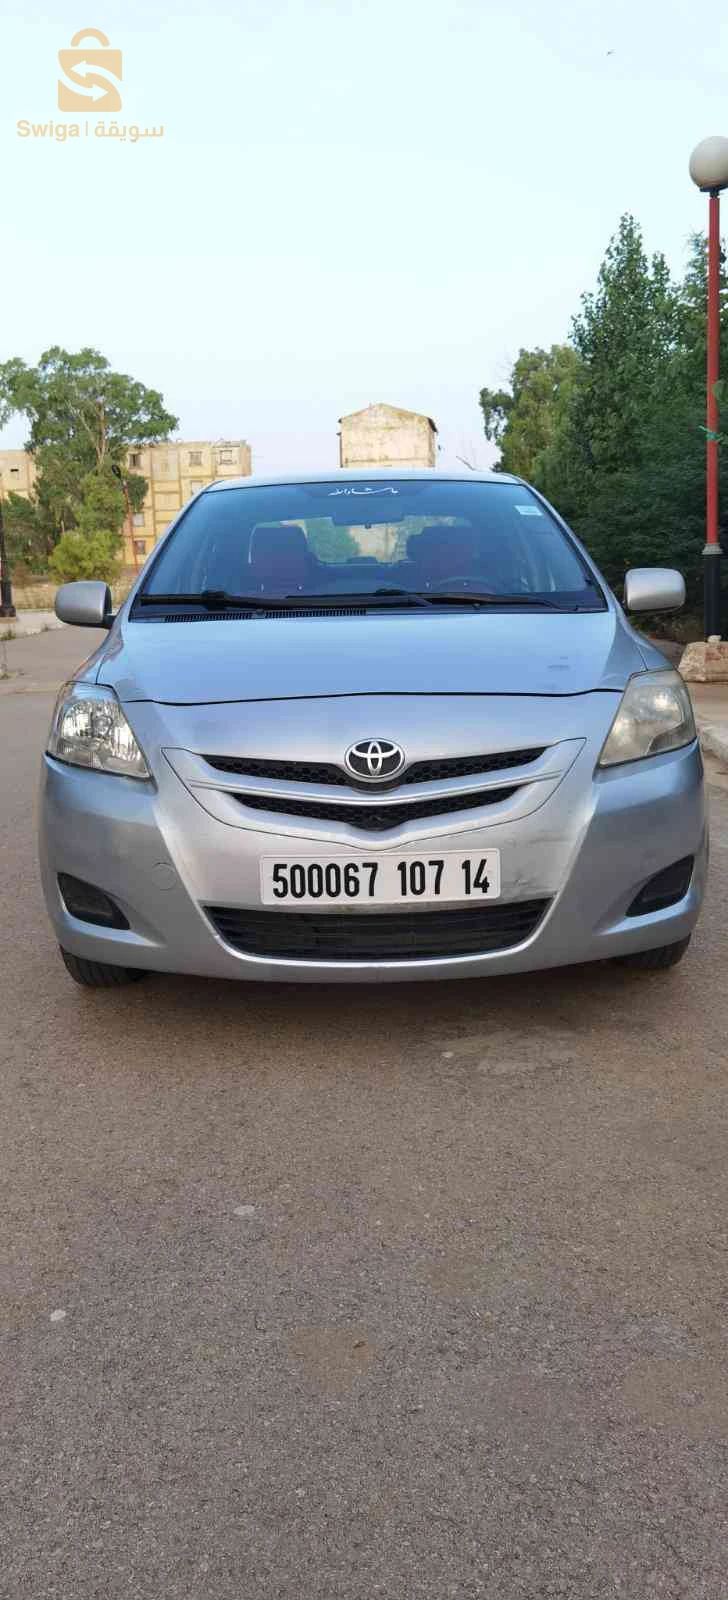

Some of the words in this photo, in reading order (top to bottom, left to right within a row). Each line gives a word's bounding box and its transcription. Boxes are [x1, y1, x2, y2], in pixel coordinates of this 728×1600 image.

[272, 862, 378, 898] 500067
[397, 860, 444, 896] 107
[461, 858, 490, 895] 14
